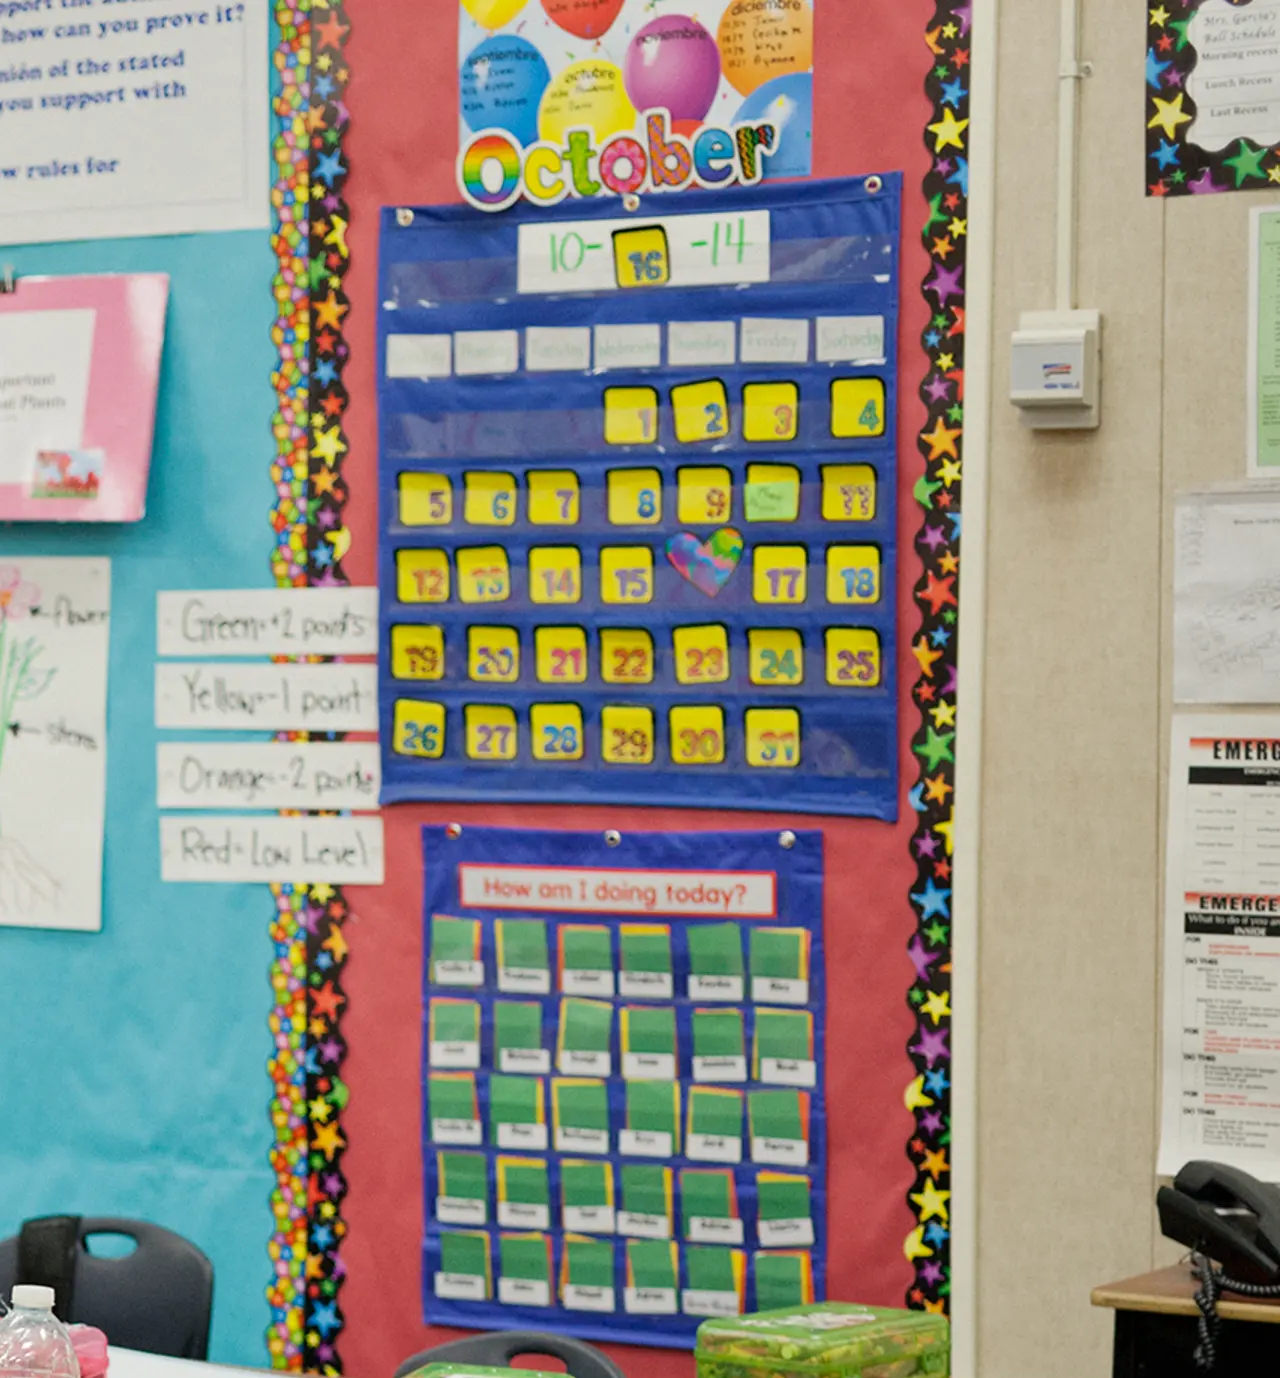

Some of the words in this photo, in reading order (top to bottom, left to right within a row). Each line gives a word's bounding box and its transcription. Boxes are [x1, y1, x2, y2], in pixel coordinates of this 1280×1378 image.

[2, 26, 45, 44] how
[55, 21, 91, 38] can
[98, 22, 139, 39] you
[146, 13, 209, 34] prove
[217, 4, 244, 23] it?
[636, 27, 709, 47] noviembre
[49, 60, 68, 78] of
[77, 57, 111, 75] the
[119, 50, 185, 72] stated
[1202, 49, 1244, 61] Morning
[1246, 48, 1278, 58] recess
[41, 88, 125, 111] support
[135, 80, 187, 100] with
[1205, 79, 1237, 90] Lunch
[1238, 76, 1273, 87] Recess
[1210, 108, 1231, 118] Last
[1234, 105, 1269, 116] Recess
[27, 159, 80, 179] rules
[86, 156, 120, 174] for
[462, 112, 775, 204] October
[637, 407, 652, 439] 1
[703, 402, 724, 433] 2
[774, 404, 793, 436] 3
[858, 398, 880, 432] 4
[428, 490, 446, 519] 5
[492, 491, 510, 520] 6
[556, 489, 575, 518] 7
[637, 488, 656, 519] 8
[705, 487, 727, 519] 9
[839, 484, 872, 516] 11
[412, 568, 443, 597] 12
[471, 567, 504, 596] 13
[542, 568, 575, 597] 14
[614, 568, 648, 598] 15
[766, 567, 802, 599] 17
[840, 567, 876, 599] 18
[404, 645, 439, 674] 19
[477, 646, 514, 677] 20
[551, 648, 583, 677] 21
[612, 648, 648, 678] 22
[685, 647, 725, 678] 23
[759, 648, 799, 680] 24
[836, 649, 876, 682] 25
[402, 720, 439, 752] 26
[476, 724, 512, 753] 27
[543, 725, 578, 754] 28
[611, 728, 648, 757] 29
[678, 728, 720, 759] 30
[759, 731, 796, 761] 31
[483, 877, 532, 897] How
[539, 881, 572, 896] am
[579, 879, 587, 899] I
[595, 880, 657, 911] doing
[666, 883, 748, 913] today?
[1199, 895, 1278, 912] EMERGE
[1187, 914, 1214, 924] What
[1251, 917, 1269, 928] you
[1233, 925, 1267, 936] INSIDE
